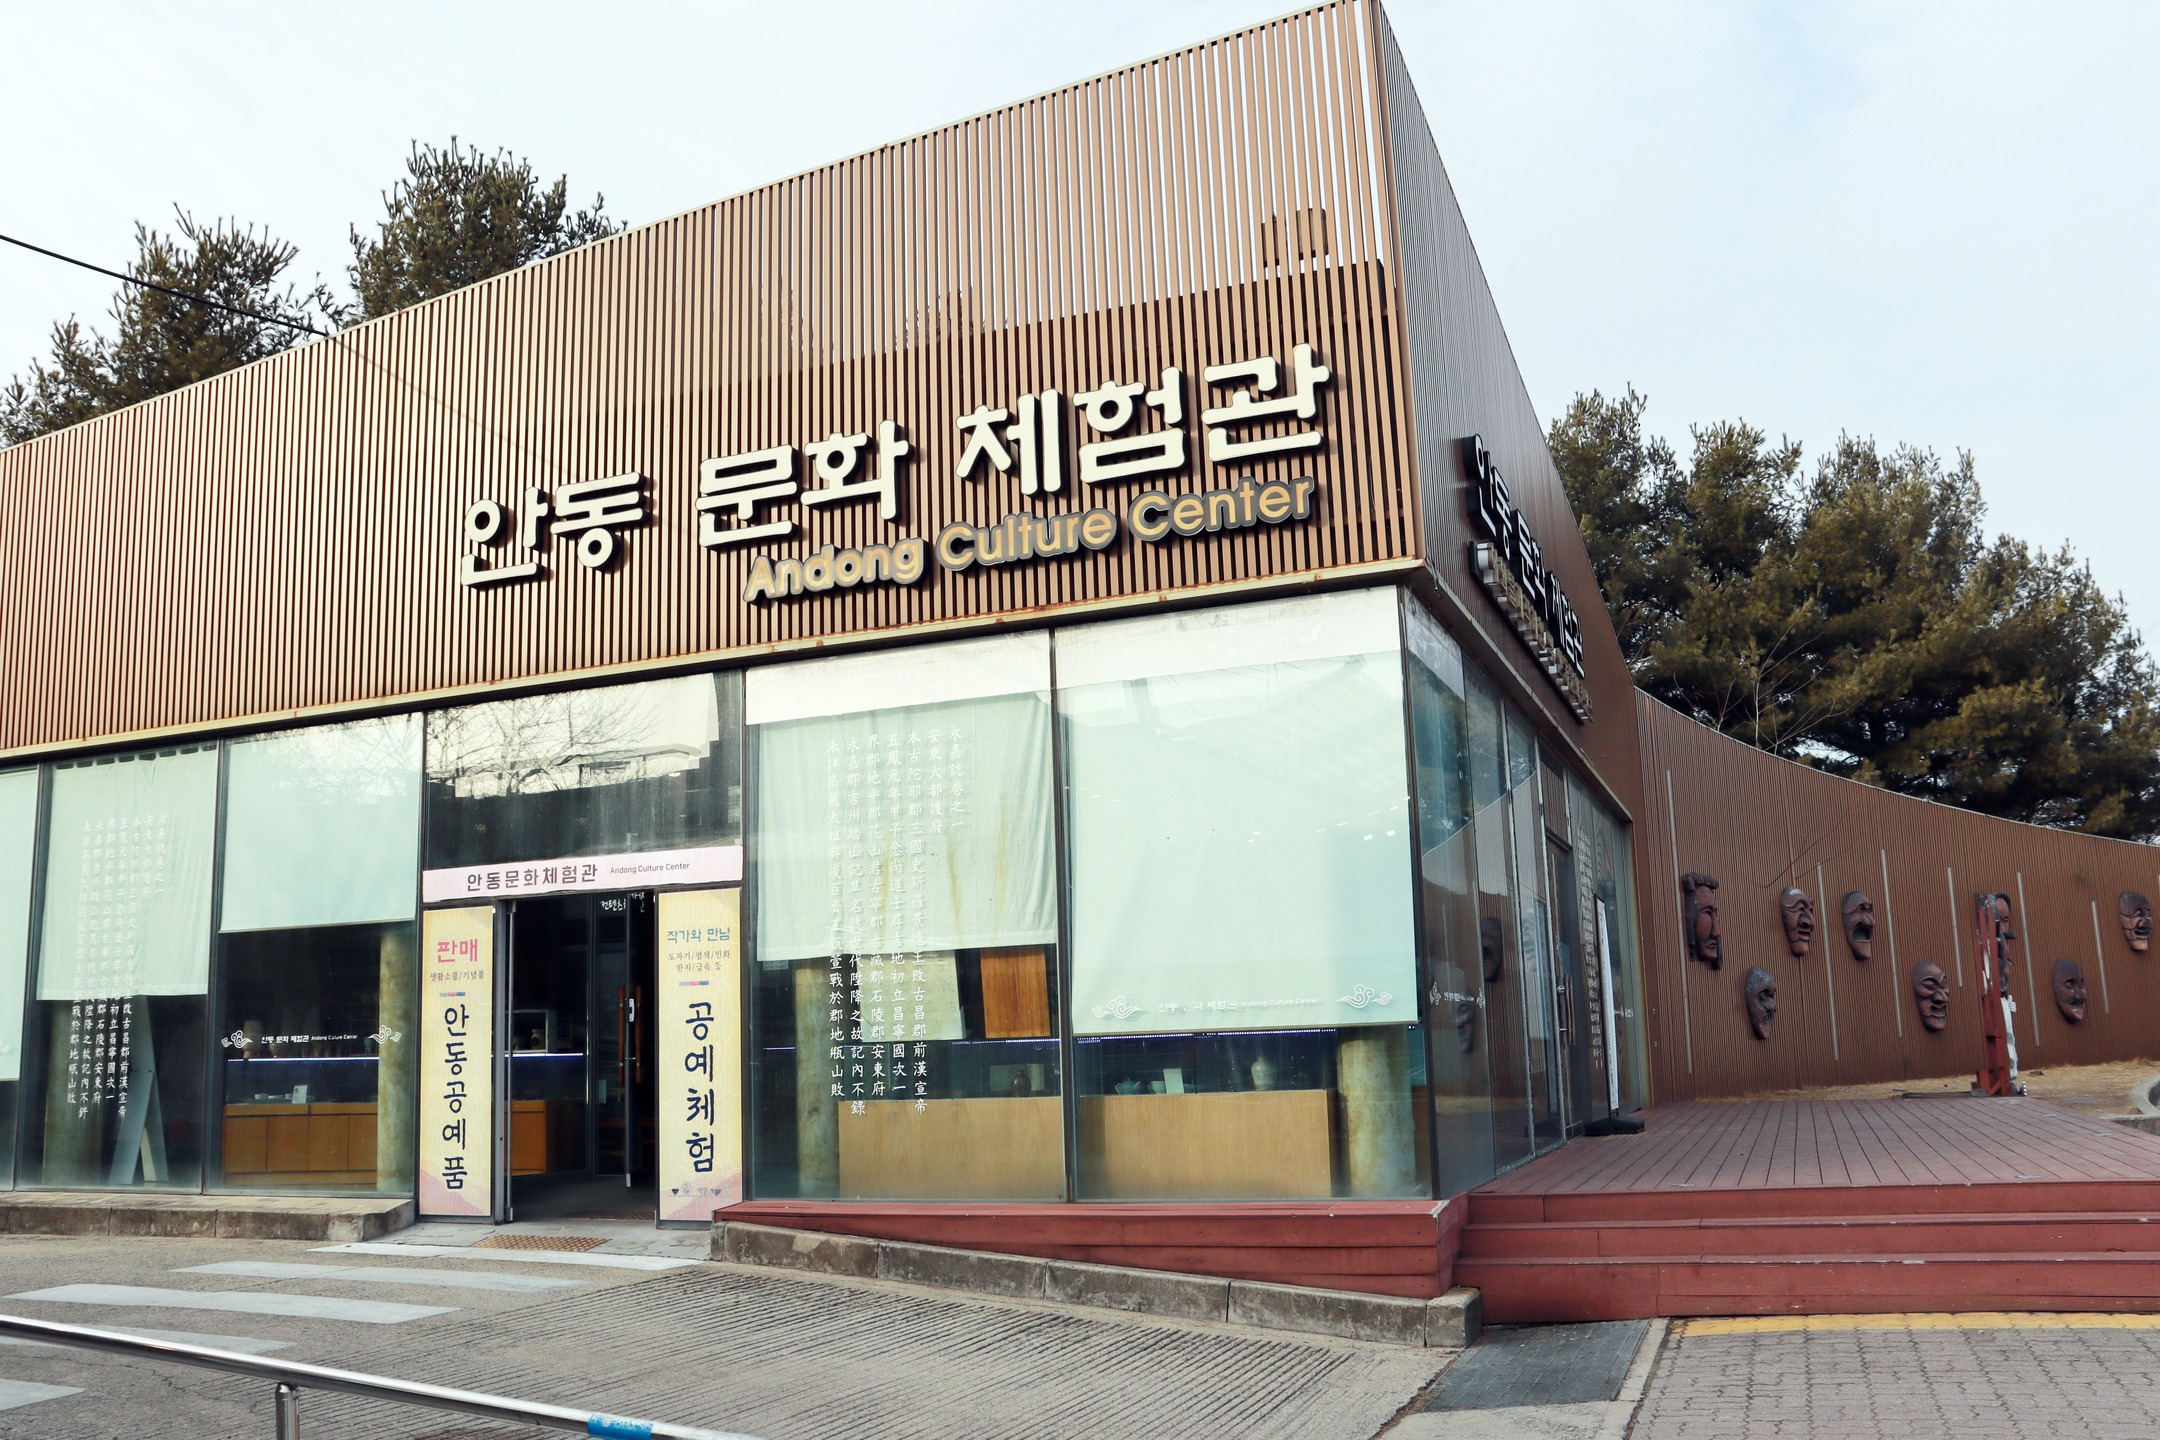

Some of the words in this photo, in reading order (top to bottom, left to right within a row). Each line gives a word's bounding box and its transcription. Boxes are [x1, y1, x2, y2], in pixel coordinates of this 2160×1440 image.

[461, 471, 648, 587] 안동
[695, 419, 911, 549] 문화
[955, 342, 1332, 497] 체험관
[745, 537, 928, 602] Andong
[938, 508, 1118, 570] Culture
[1128, 476, 1316, 541] Center
[927, 728, 945, 836] 安東大都護府
[948, 725, 965, 829] 永嘉誌卷之一
[467, 863, 598, 892] 안동문화체험관
[610, 866, 637, 875] Andong
[638, 864, 664, 873] Culture
[665, 862, 690, 871] Center
[667, 929, 702, 944] 작가와
[707, 927, 731, 942] 만남
[437, 939, 478, 963] 판매
[668, 950, 731, 961] 도자기/염색/민화
[430, 971, 485, 982] 생활소품/기념품
[677, 962, 711, 972] 한지/금속
[715, 962, 722, 971] 등
[442, 1004, 469, 1190] 안동공예품
[684, 1002, 715, 1173] 공예체험
